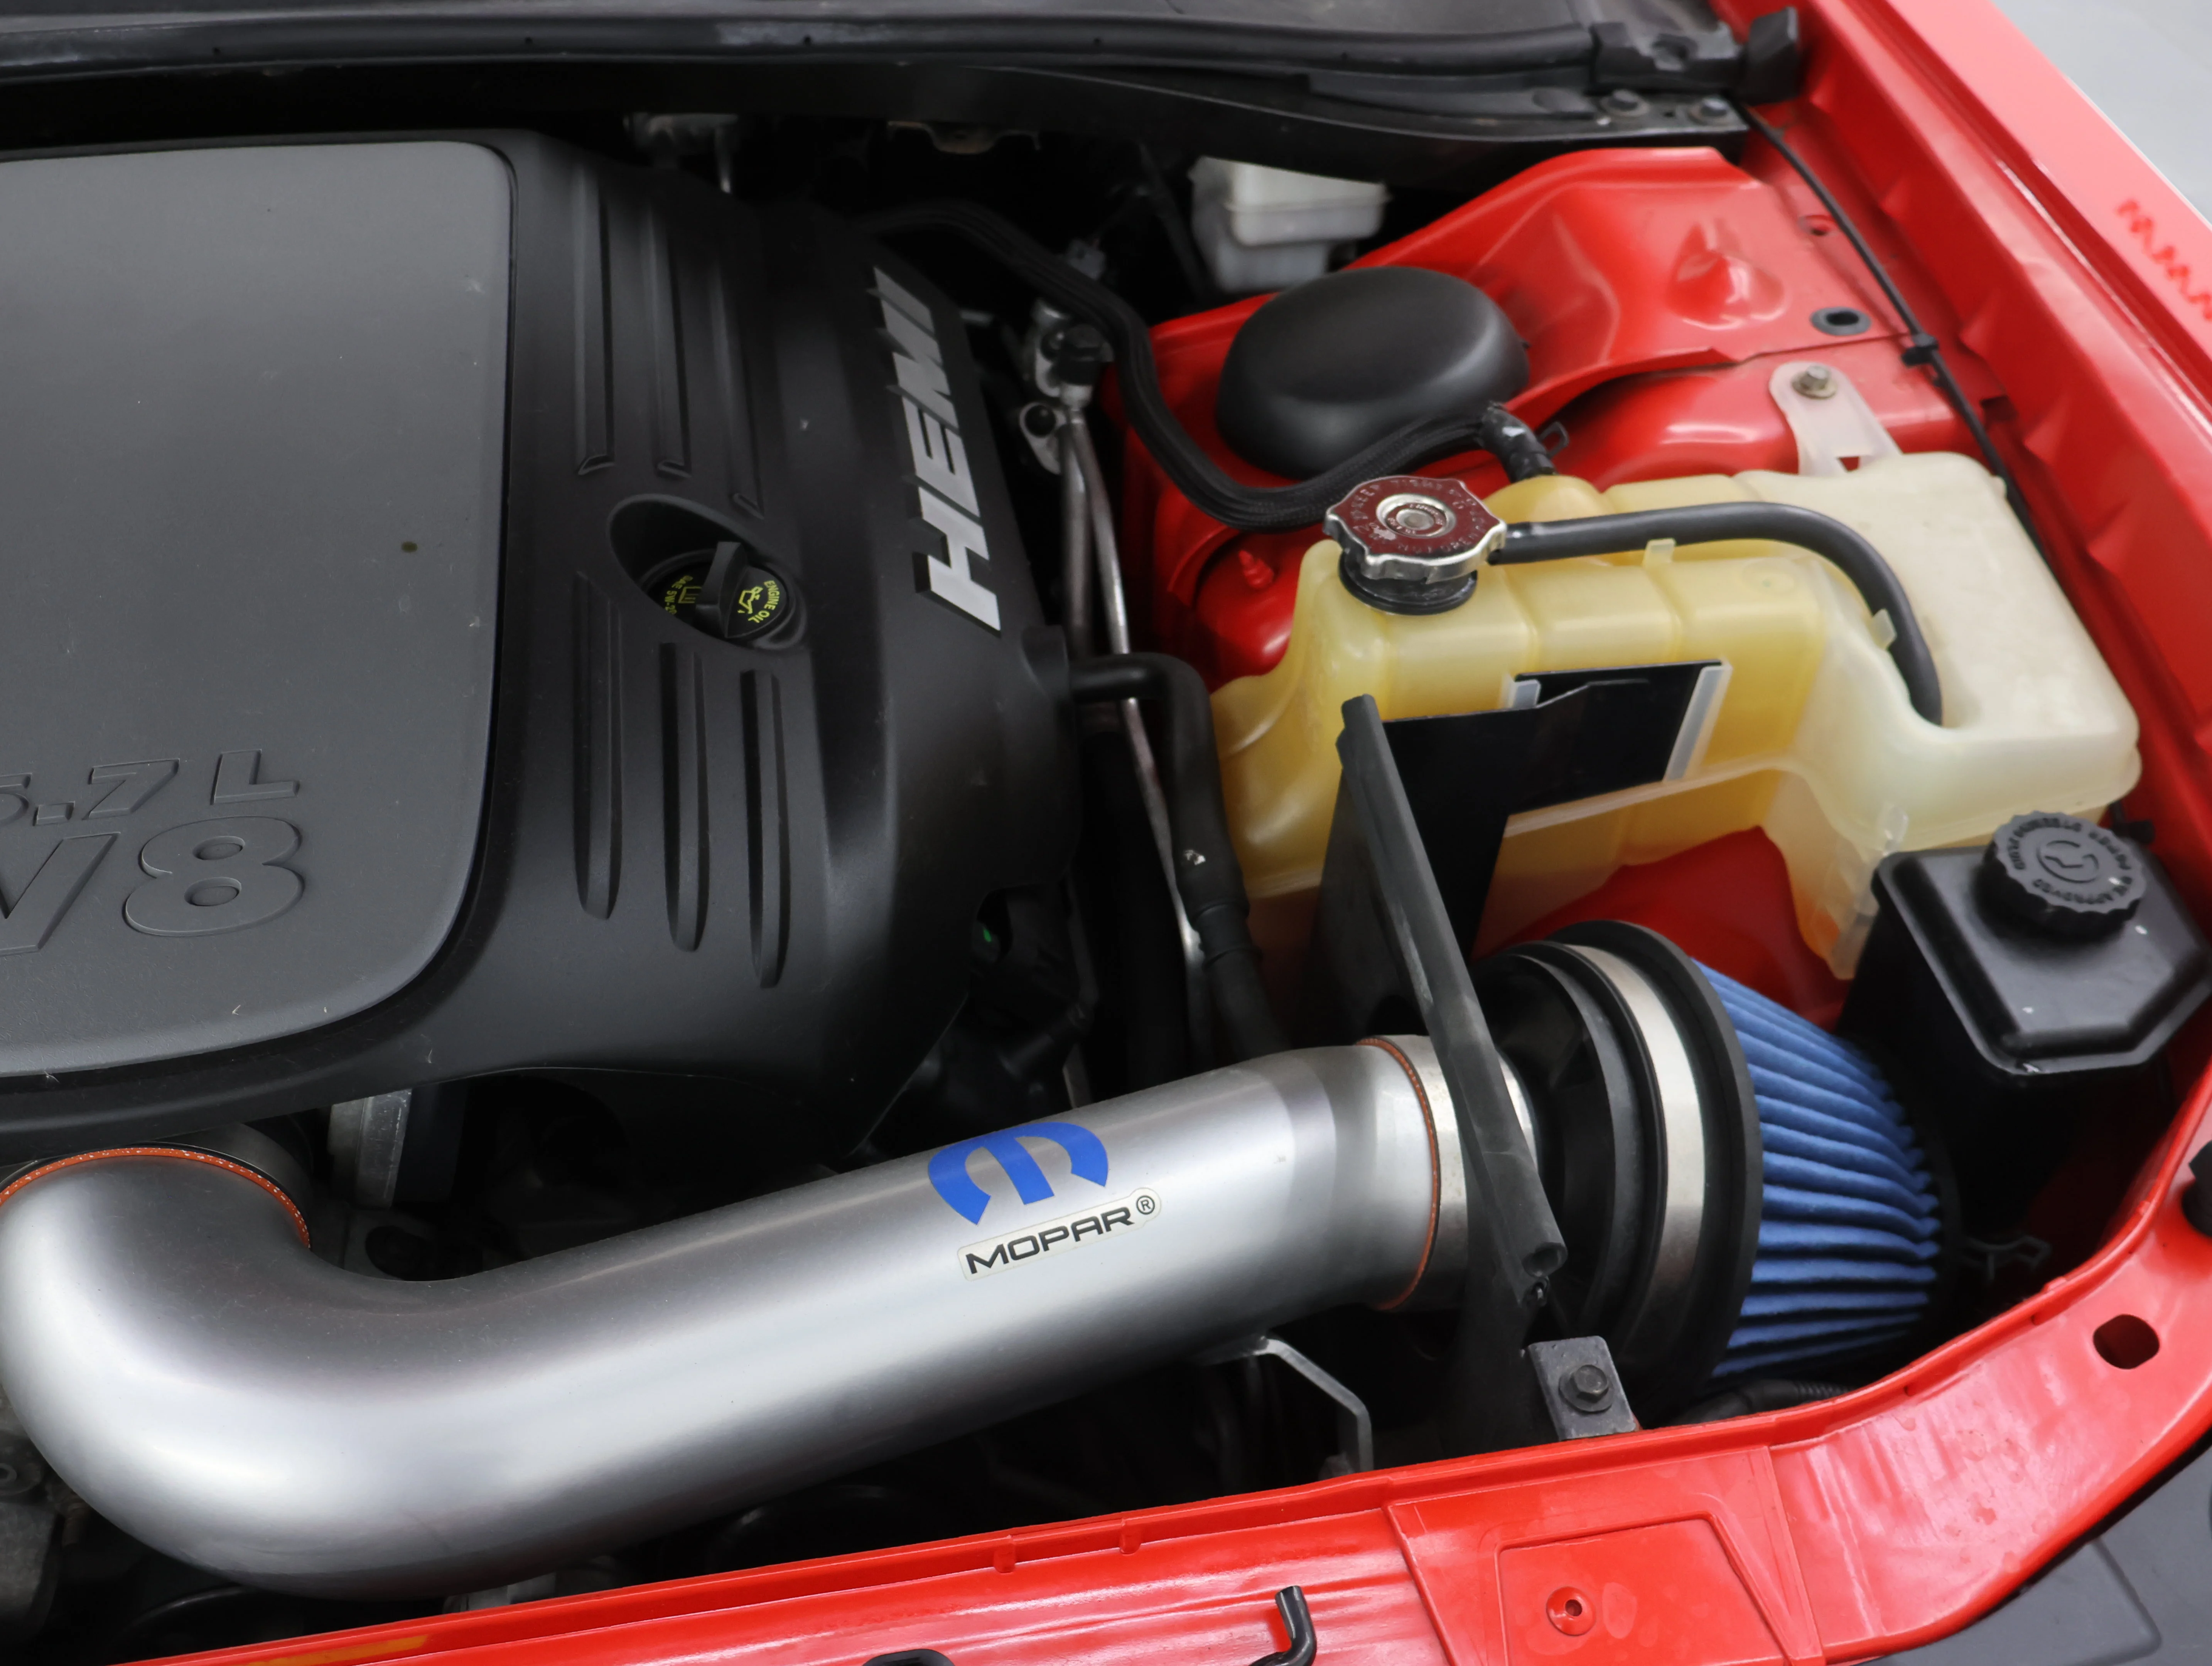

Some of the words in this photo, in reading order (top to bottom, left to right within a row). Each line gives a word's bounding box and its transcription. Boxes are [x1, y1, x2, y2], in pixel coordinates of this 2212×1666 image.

[873, 266, 1001, 631] HEMI
[763, 580, 780, 610] ENGINE
[748, 610, 770, 623] OIL
